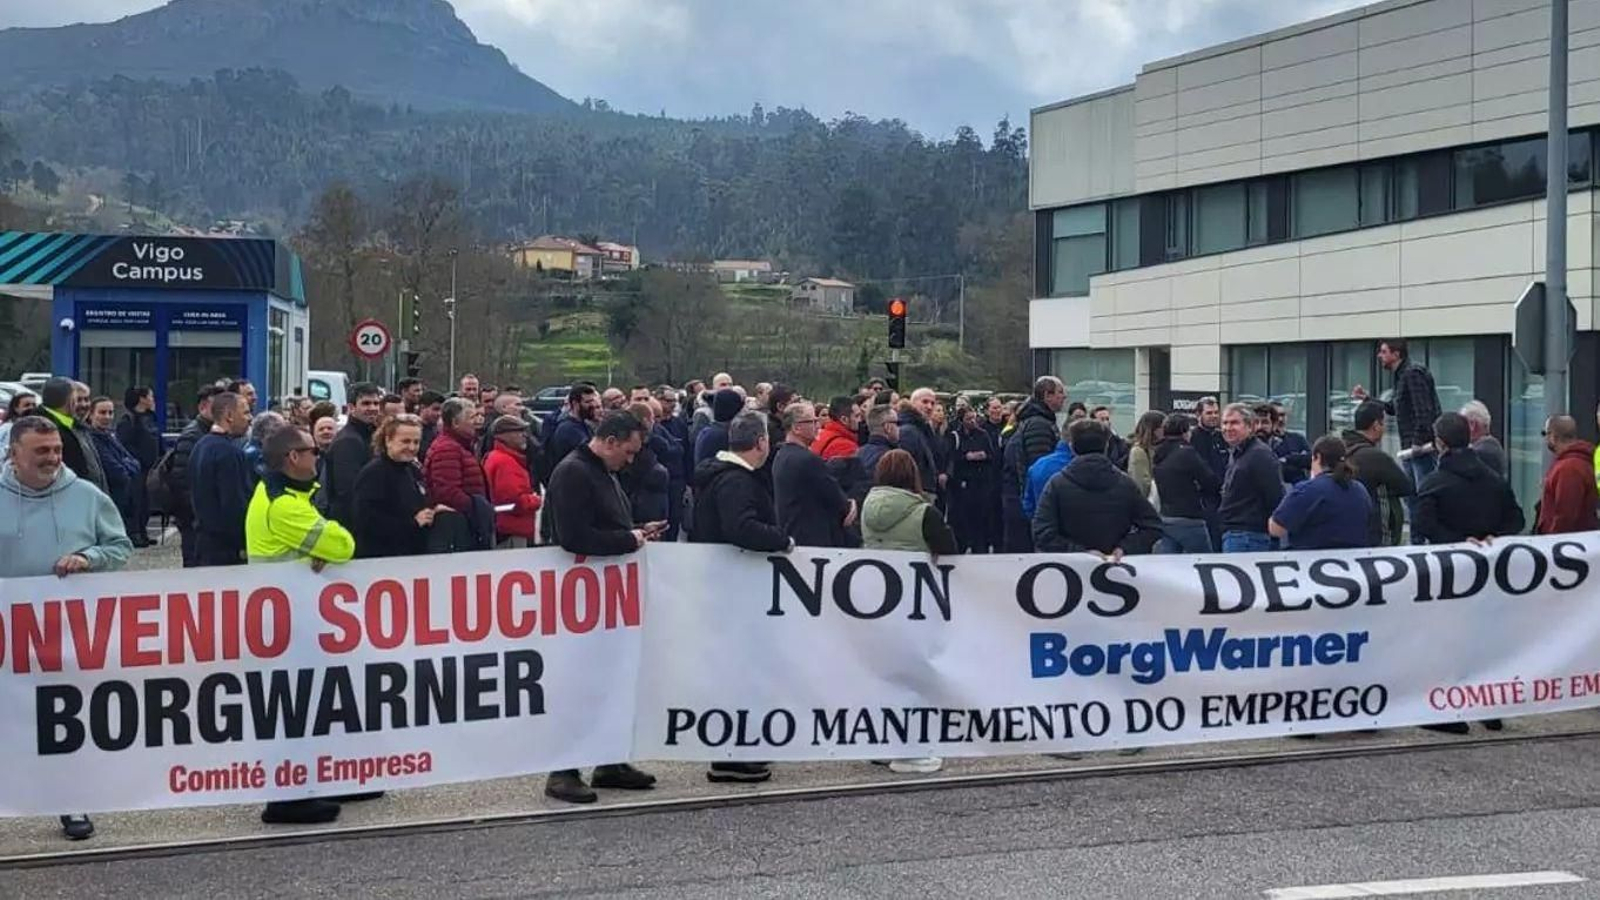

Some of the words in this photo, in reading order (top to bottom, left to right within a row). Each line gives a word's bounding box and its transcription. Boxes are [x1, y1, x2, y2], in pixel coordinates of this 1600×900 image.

[112, 262, 203, 283] Campus
[132, 242, 184, 263] Vigo
[360, 333, 382, 346] 20
[766, 555, 955, 621] NON
[1015, 561, 1141, 620] OS
[1193, 541, 1590, 615] DESPIDOS
[0, 586, 291, 673] NVENIO
[318, 553, 641, 654] SOLUCIÓN
[1029, 627, 1369, 685] BorgWarner
[36, 648, 546, 756] BORGWARNER
[664, 708, 796, 747] POLO
[811, 701, 1111, 746] MANTEMENTO
[1124, 697, 1186, 734] DO
[1200, 683, 1388, 728] EMPREGO
[1429, 675, 1526, 711] COMITÉ
[1533, 677, 1563, 702] DE
[169, 760, 264, 793] Comité
[275, 759, 307, 786] de
[316, 752, 432, 784] Empresa
